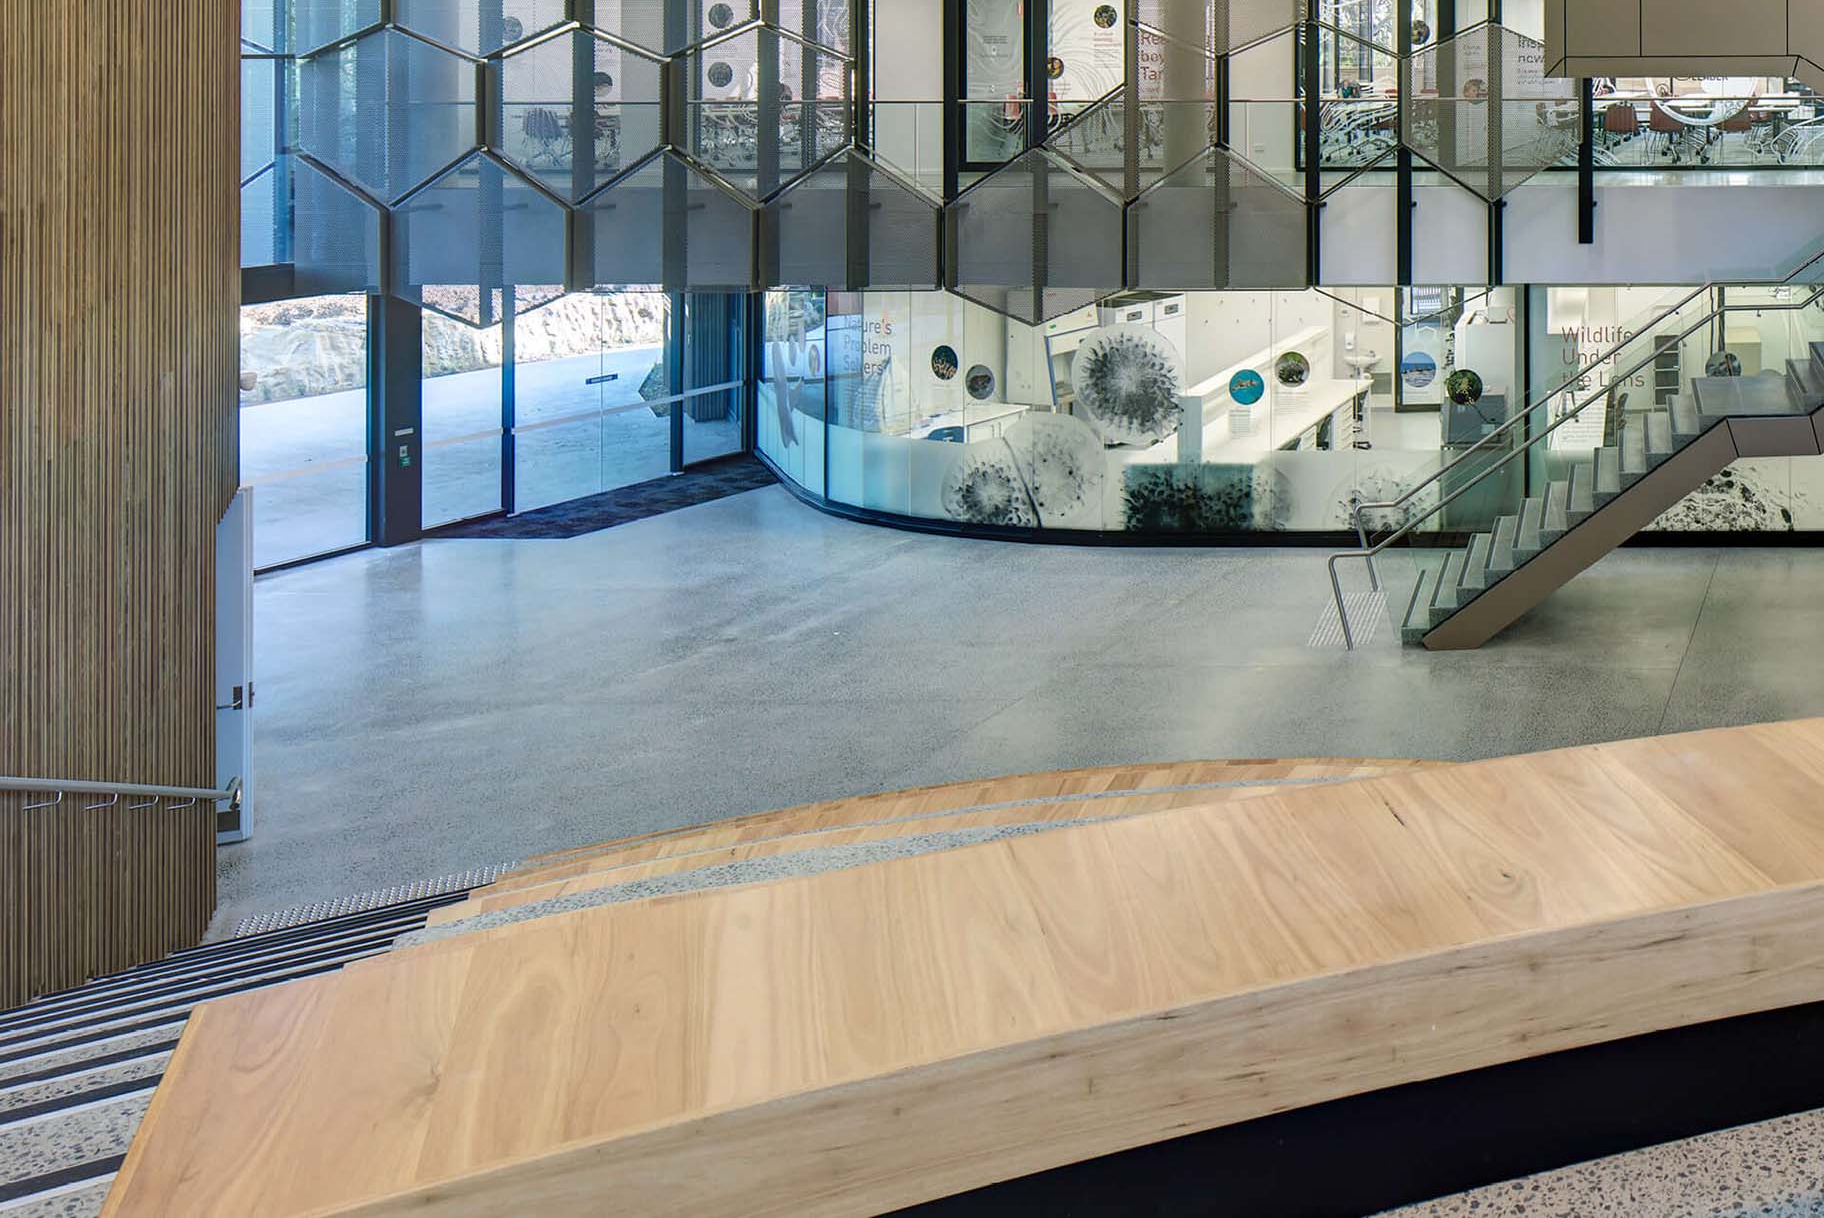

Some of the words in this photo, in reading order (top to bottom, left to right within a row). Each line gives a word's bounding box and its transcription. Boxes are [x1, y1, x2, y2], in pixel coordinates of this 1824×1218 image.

[844, 315, 892, 334] Nature's
[1561, 326, 1634, 343] Wildlife
[844, 334, 892, 356] Problem
[843, 354, 885, 376] Solers
[1561, 348, 1622, 365] Under
[1599, 370, 1645, 388] Lens
